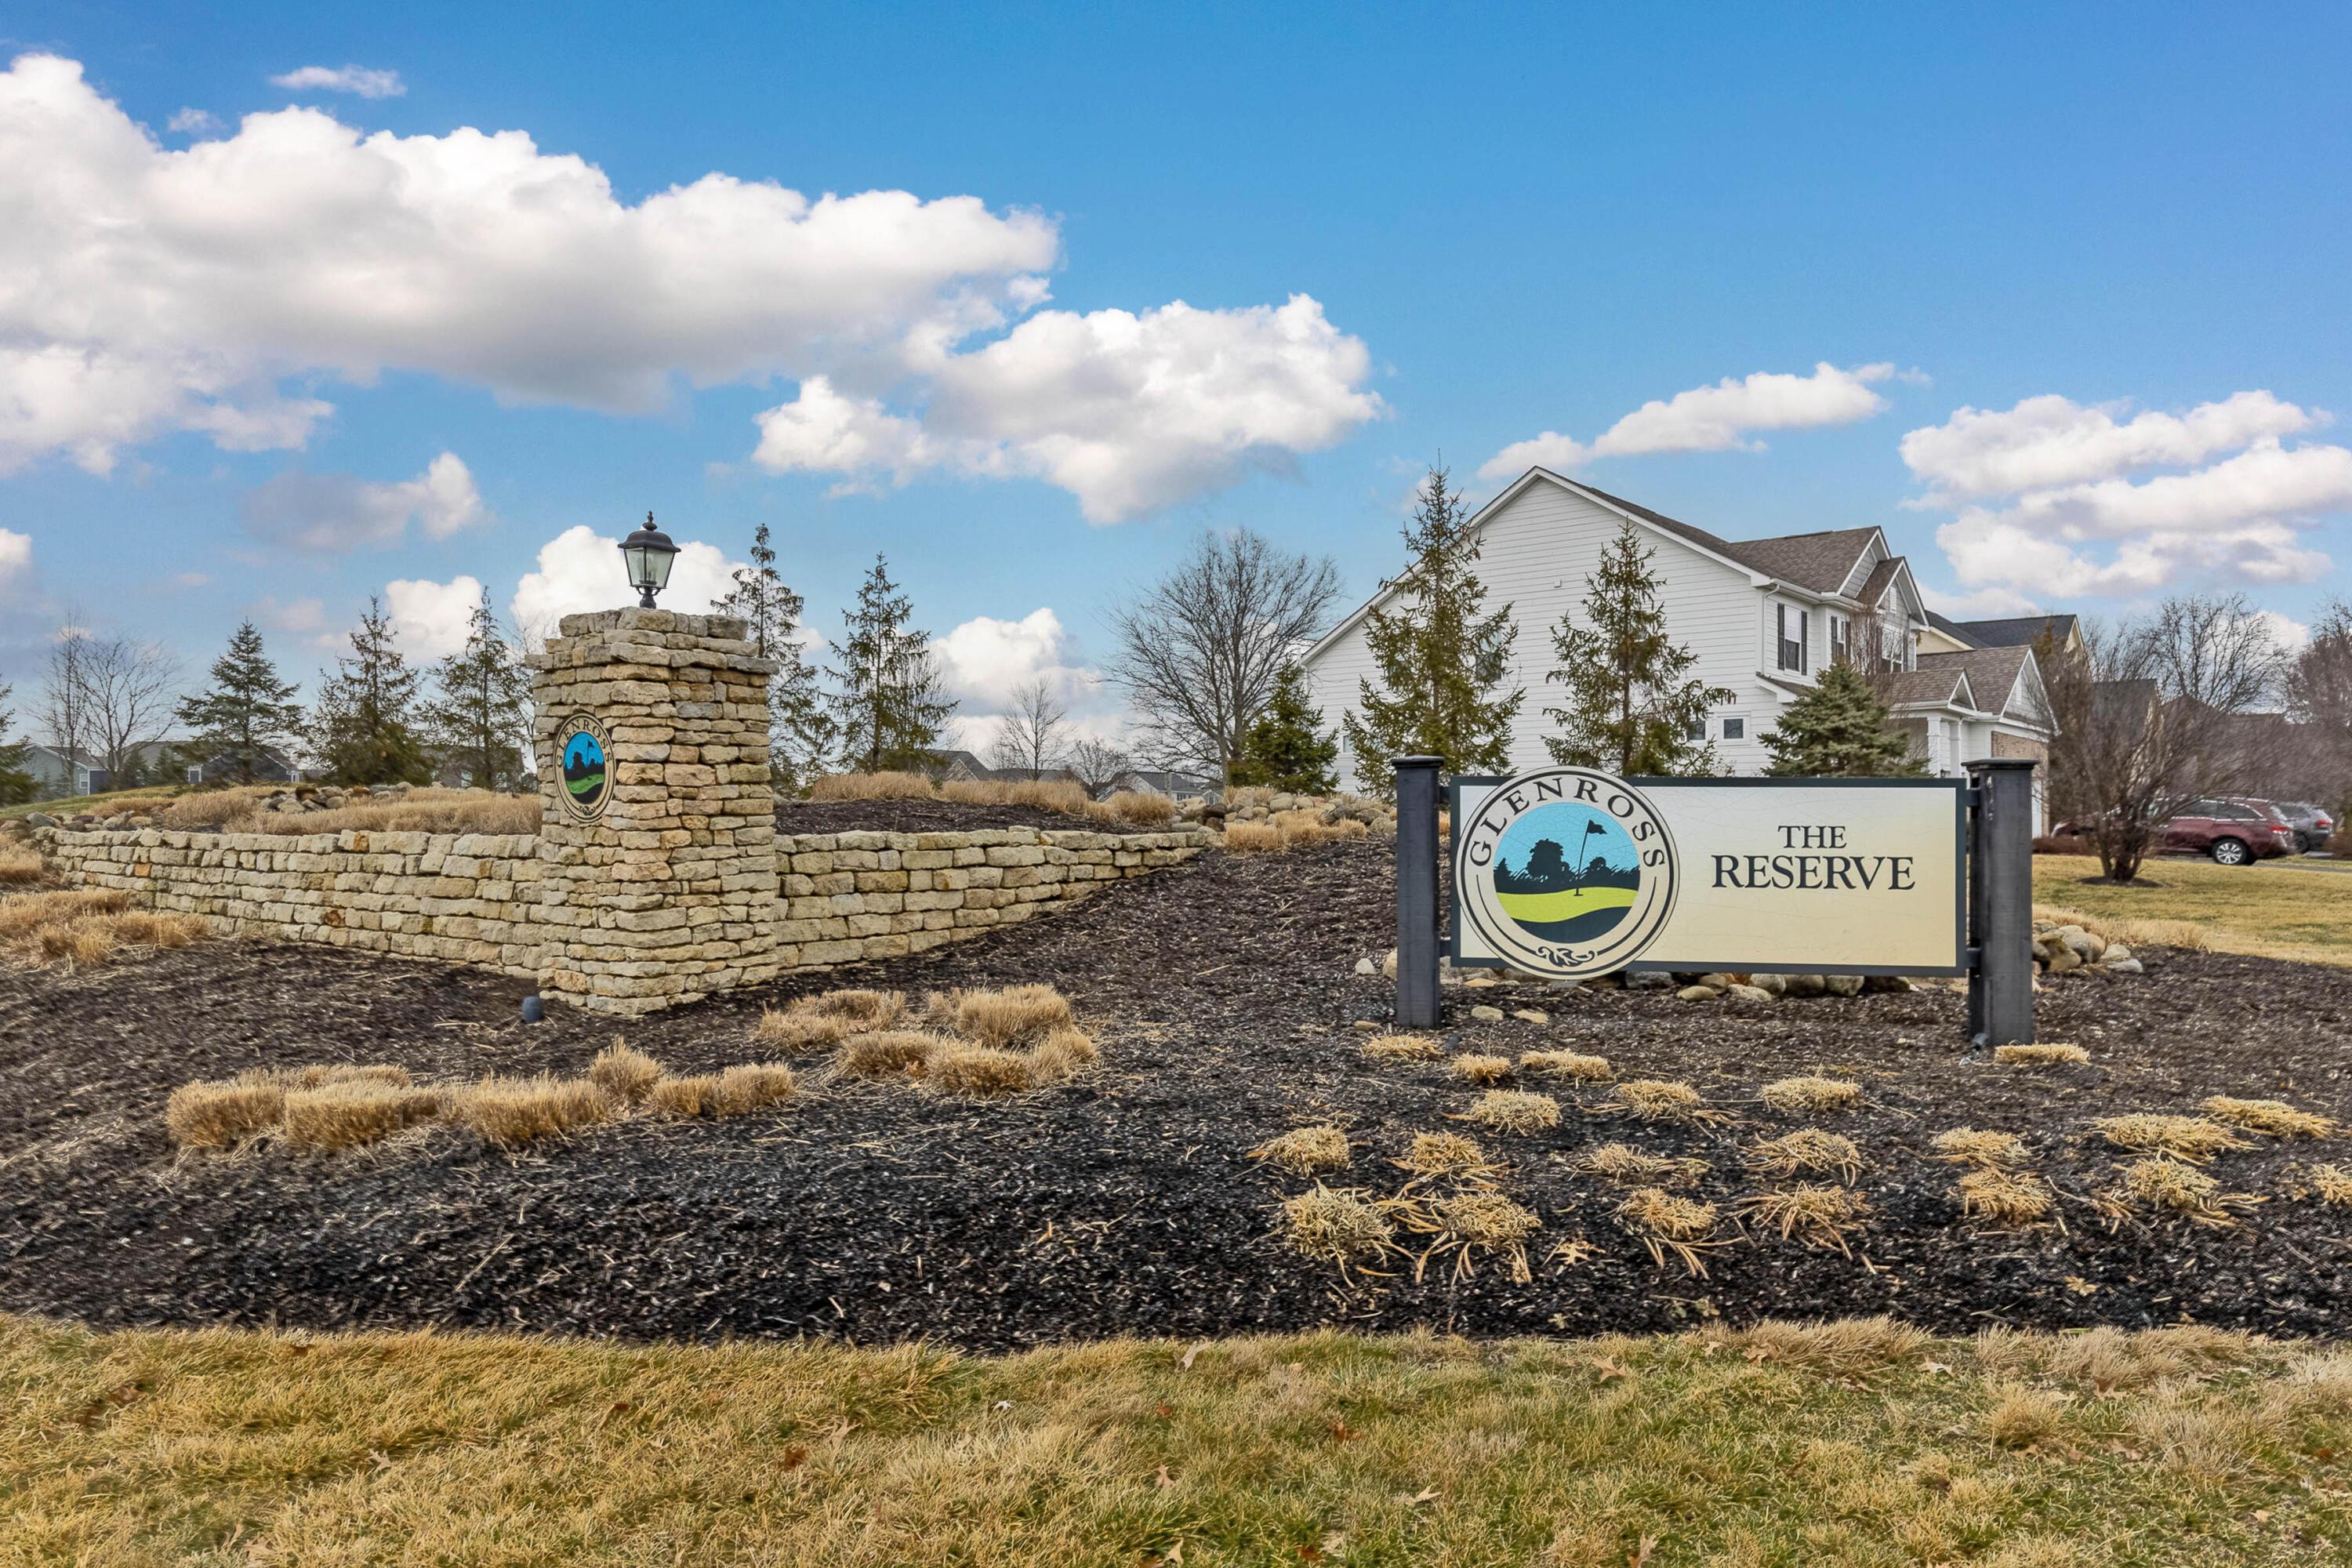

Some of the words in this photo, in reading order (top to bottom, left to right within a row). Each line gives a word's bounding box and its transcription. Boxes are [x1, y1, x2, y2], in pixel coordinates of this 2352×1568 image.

[556, 719, 612, 768] GLENROSS
[1469, 777, 1665, 867] GLENROSS
[1777, 826, 1846, 848] THE
[1711, 855, 1915, 891] RESERVE
